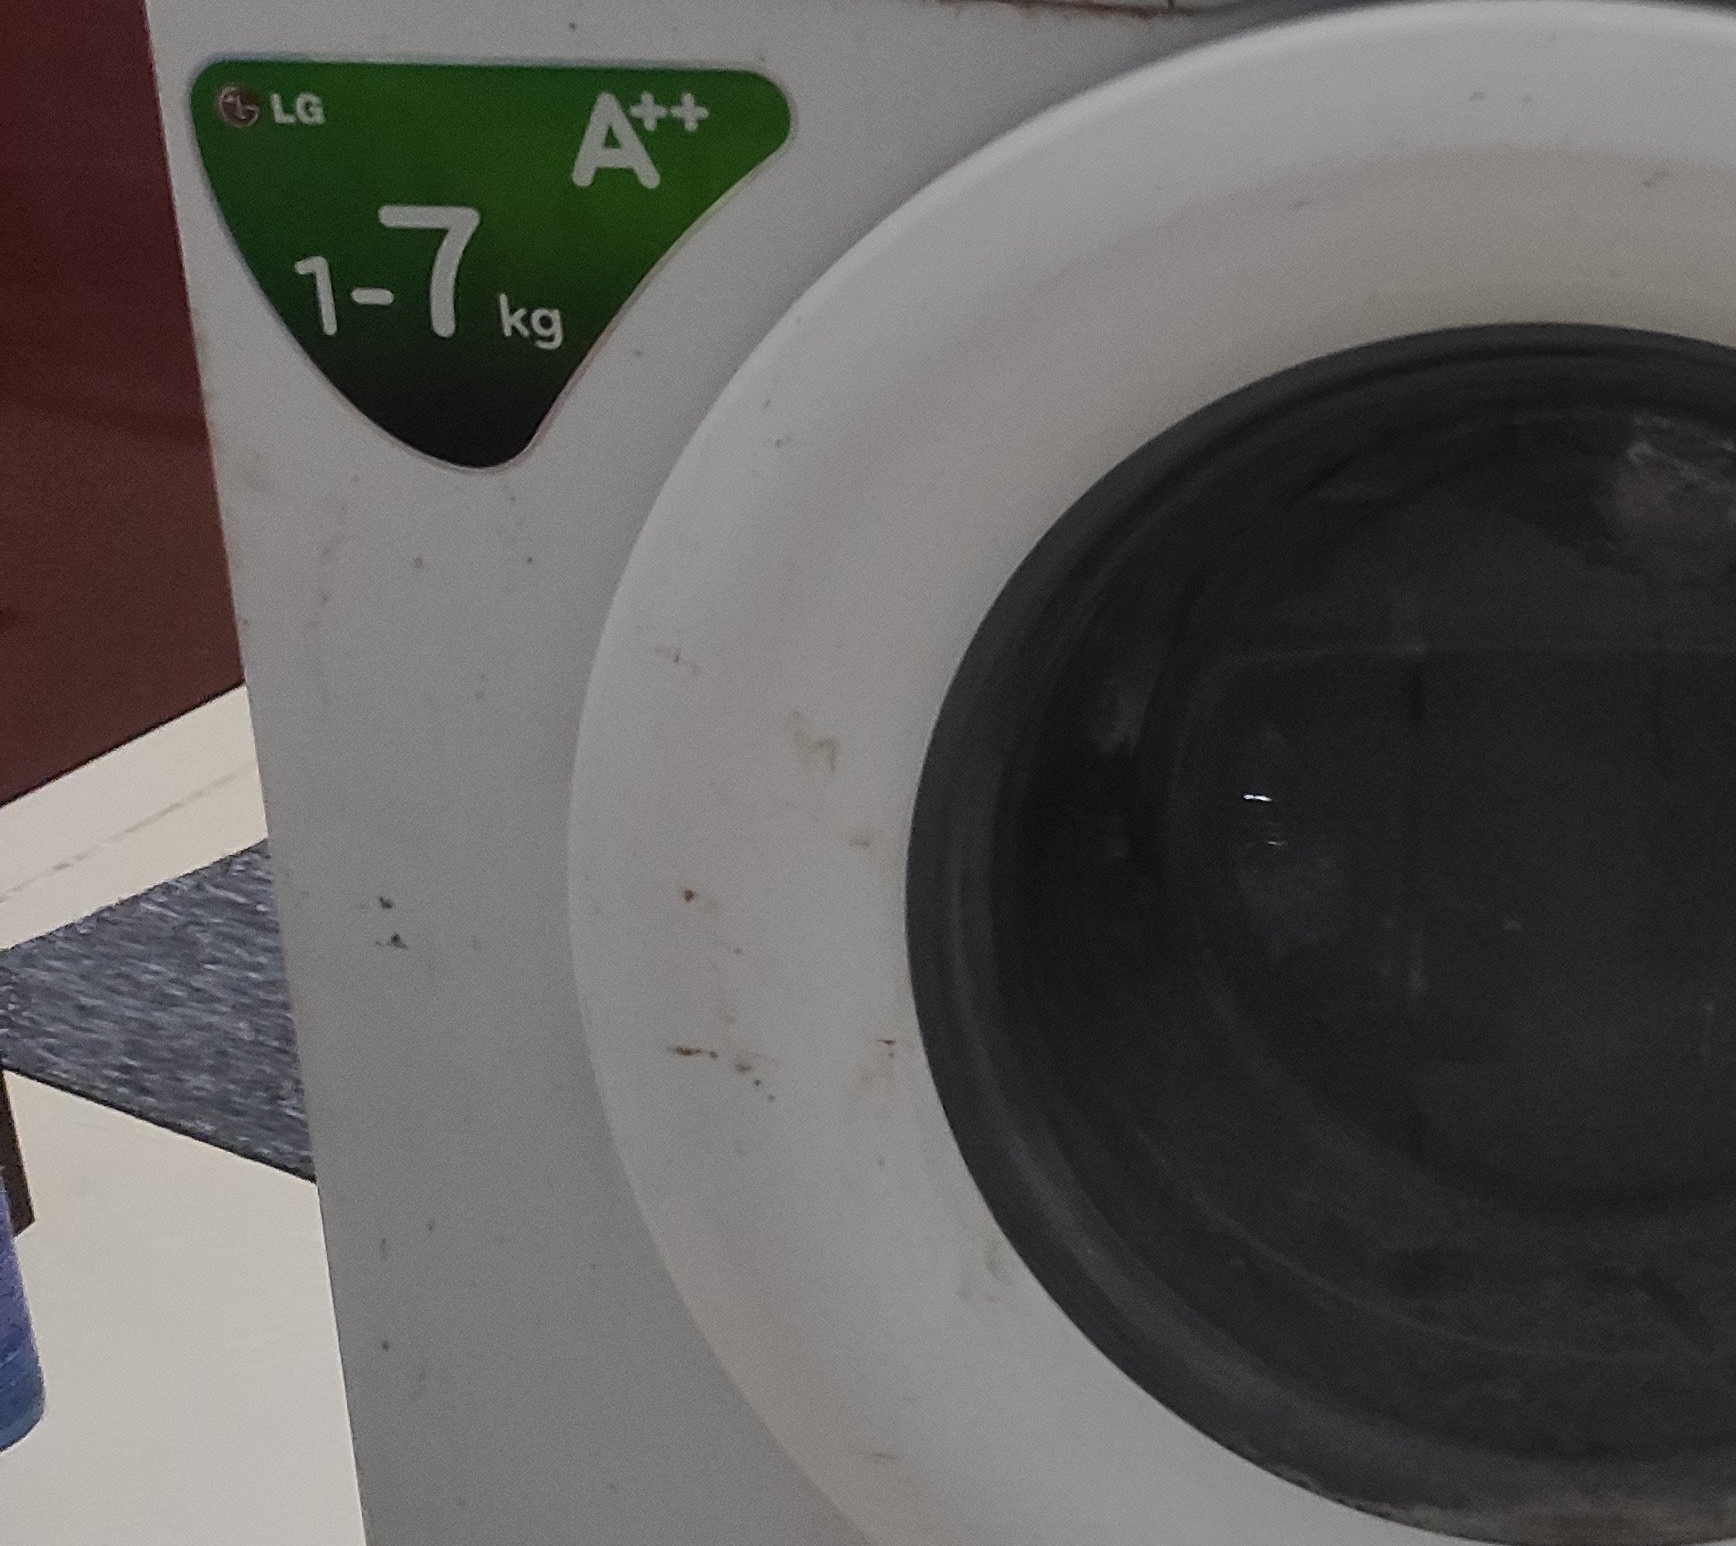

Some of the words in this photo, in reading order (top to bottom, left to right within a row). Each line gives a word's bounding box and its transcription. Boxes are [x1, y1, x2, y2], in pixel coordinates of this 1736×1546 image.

[270, 92, 325, 125] LG
[572, 91, 710, 189] A++
[499, 292, 563, 350] kg
